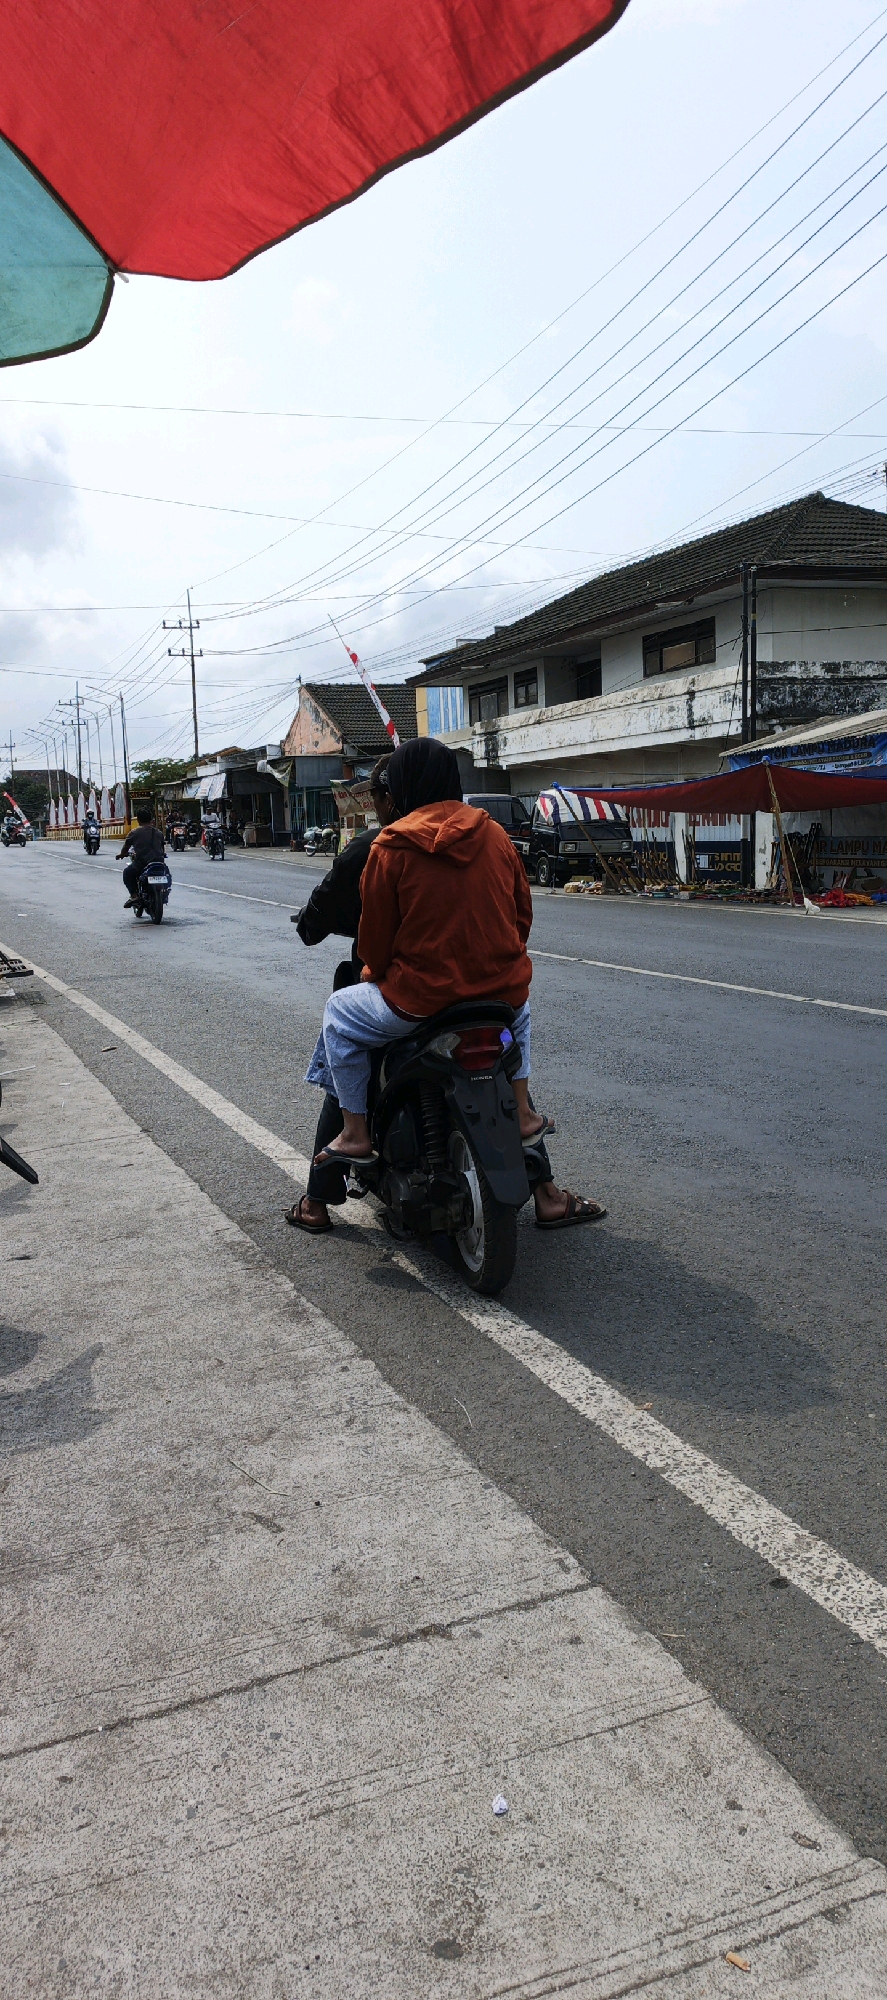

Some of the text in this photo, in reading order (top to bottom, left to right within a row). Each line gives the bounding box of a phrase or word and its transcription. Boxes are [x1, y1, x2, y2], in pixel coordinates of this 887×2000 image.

[750, 736, 877, 763] DOTOR LAMPU MADURA
[830, 840, 869, 855] LAMPU
